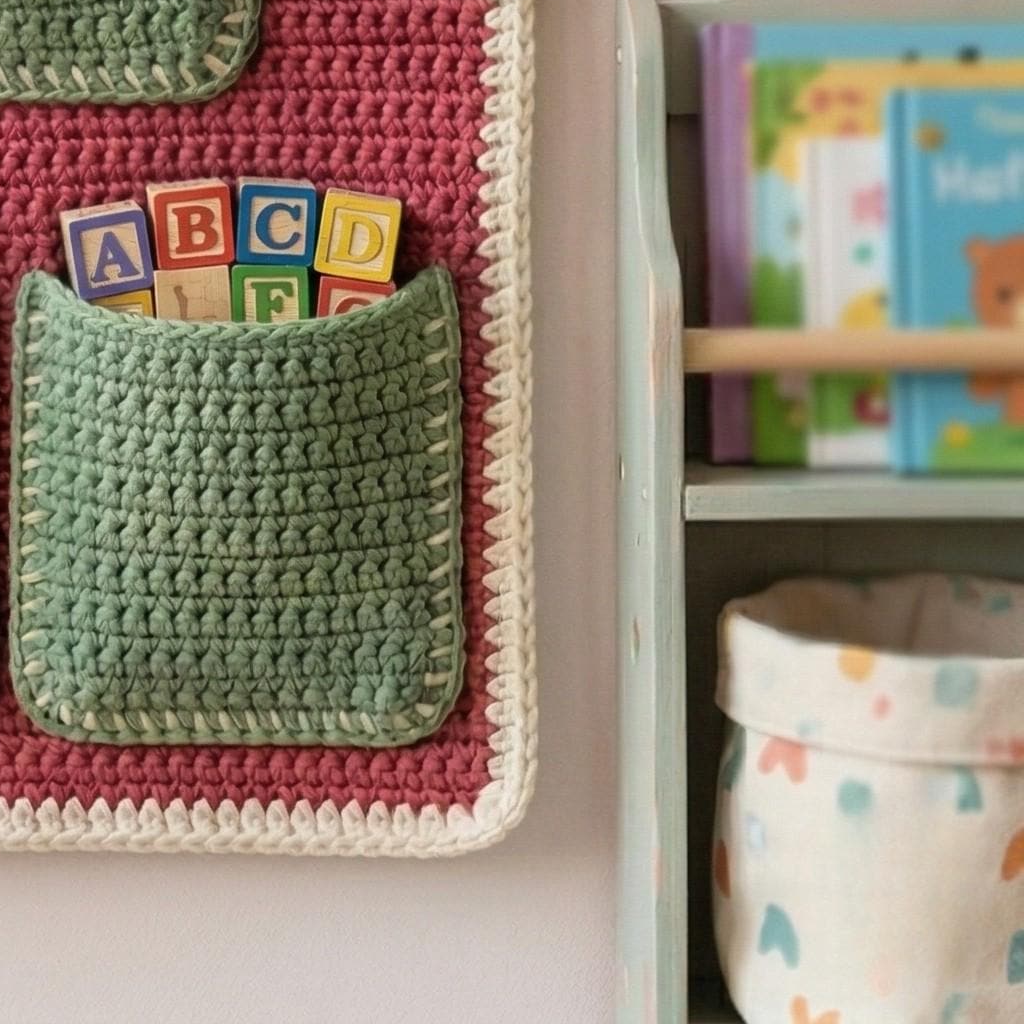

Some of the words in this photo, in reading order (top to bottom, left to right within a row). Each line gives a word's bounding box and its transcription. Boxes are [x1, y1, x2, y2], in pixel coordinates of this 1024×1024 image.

[172, 204, 219, 254] B
[255, 202, 302, 251] C
[331, 212, 384, 264] D
[90, 231, 140, 281] A
[250, 281, 294, 323] F
